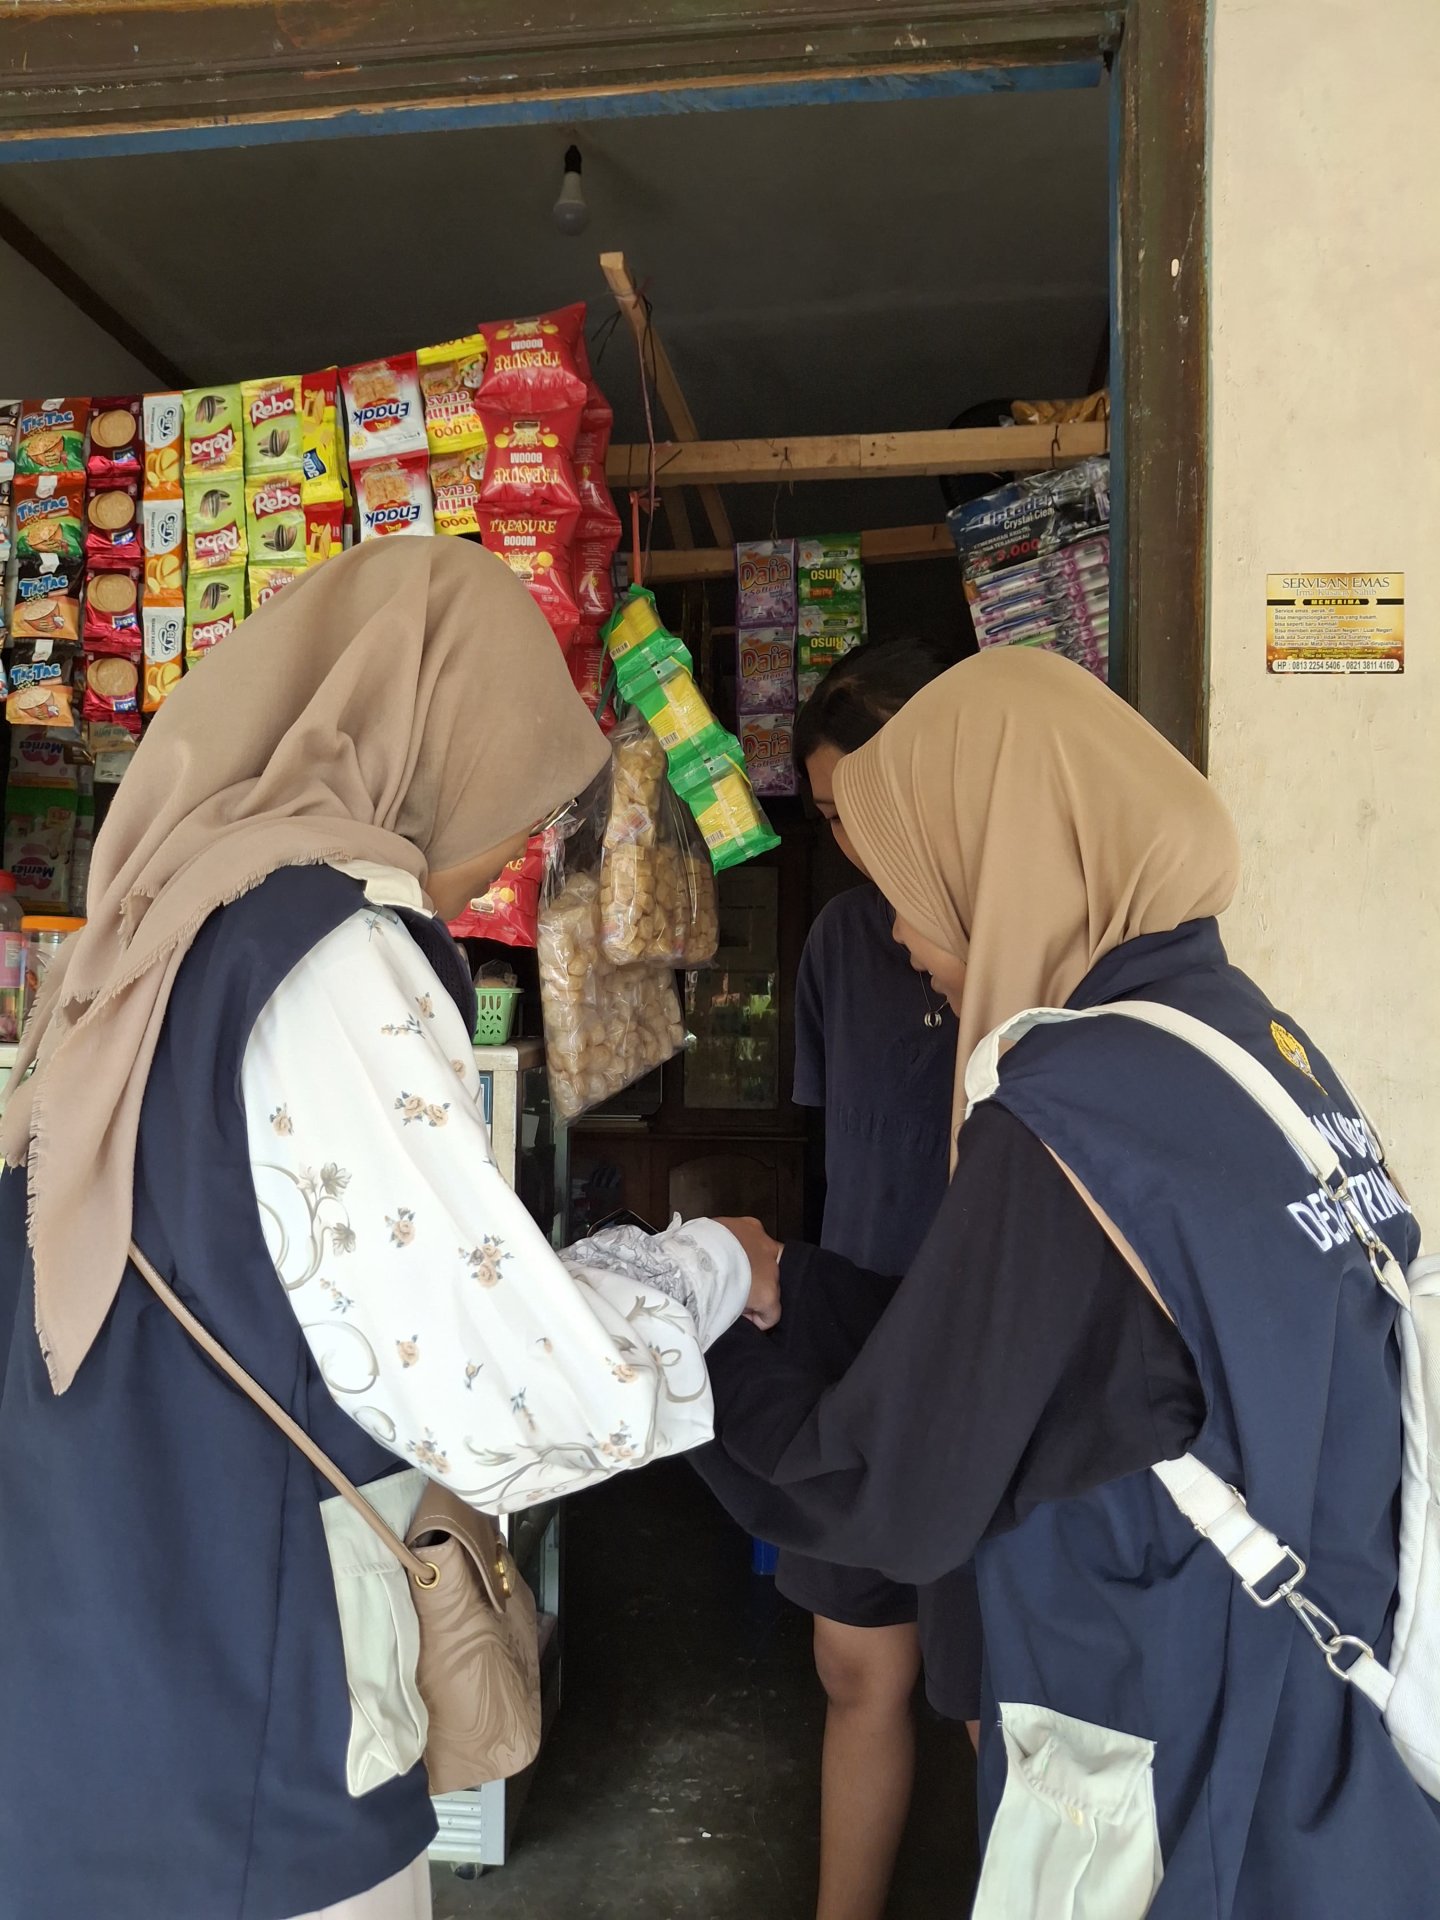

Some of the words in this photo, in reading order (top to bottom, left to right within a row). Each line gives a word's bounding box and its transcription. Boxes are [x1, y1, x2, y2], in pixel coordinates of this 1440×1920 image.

[494, 351, 562, 373] TREASURE
[427, 391, 470, 406] GELAS
[251, 397, 294, 424] Rebo
[353, 402, 410, 426] Enaak
[434, 422, 473, 438] 1.000
[191, 429, 235, 457] Rebo
[493, 465, 560, 484] TREASURE
[436, 483, 475, 497] GELAS
[254, 489, 300, 515] Rebo
[364, 505, 421, 528] Enaak
[489, 519, 558, 534] TREASURE
[1004, 512, 1034, 530] Crystal
[195, 526, 241, 553] Rebo
[740, 558, 792, 591] Daia
[810, 568, 844, 582] Rinso
[1282, 577, 1349, 589] SERVISAN
[1352, 577, 1390, 588] EMAS
[158, 619, 178, 656] Gery
[193, 617, 235, 645] Rebo
[810, 637, 844, 650] Rinso
[741, 646, 793, 678] Daia
[1278, 662, 1286, 670] HP
[1292, 661, 1307, 670] 0813
[1309, 661, 1324, 670] 2254
[1325, 661, 1340, 670] 5406
[1346, 661, 1360, 670] 0821
[1363, 661, 1377, 670] 3811
[743, 733, 791, 763] Daia
[11, 864, 55, 878] Merries
